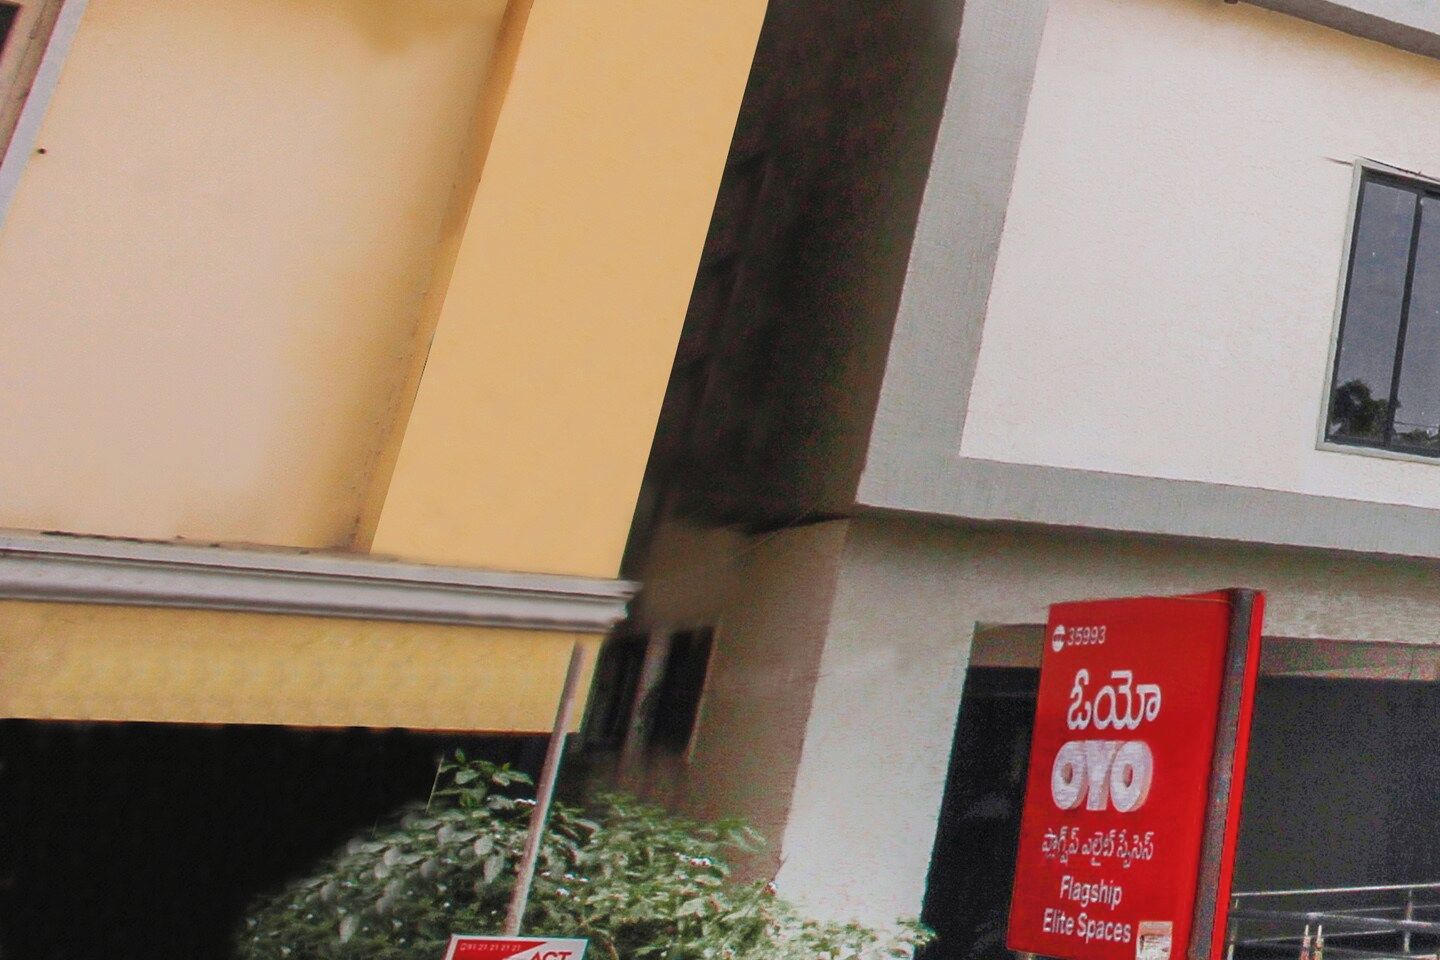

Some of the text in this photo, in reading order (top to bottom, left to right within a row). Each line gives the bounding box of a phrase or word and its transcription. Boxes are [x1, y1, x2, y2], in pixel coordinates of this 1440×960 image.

[1067, 625, 1106, 646] 35993
[1067, 668, 1162, 730] ఓయో
[1051, 740, 1153, 812] OYO
[1060, 875, 1122, 911] Flagship
[1042, 907, 1132, 944] Elite Spaces
